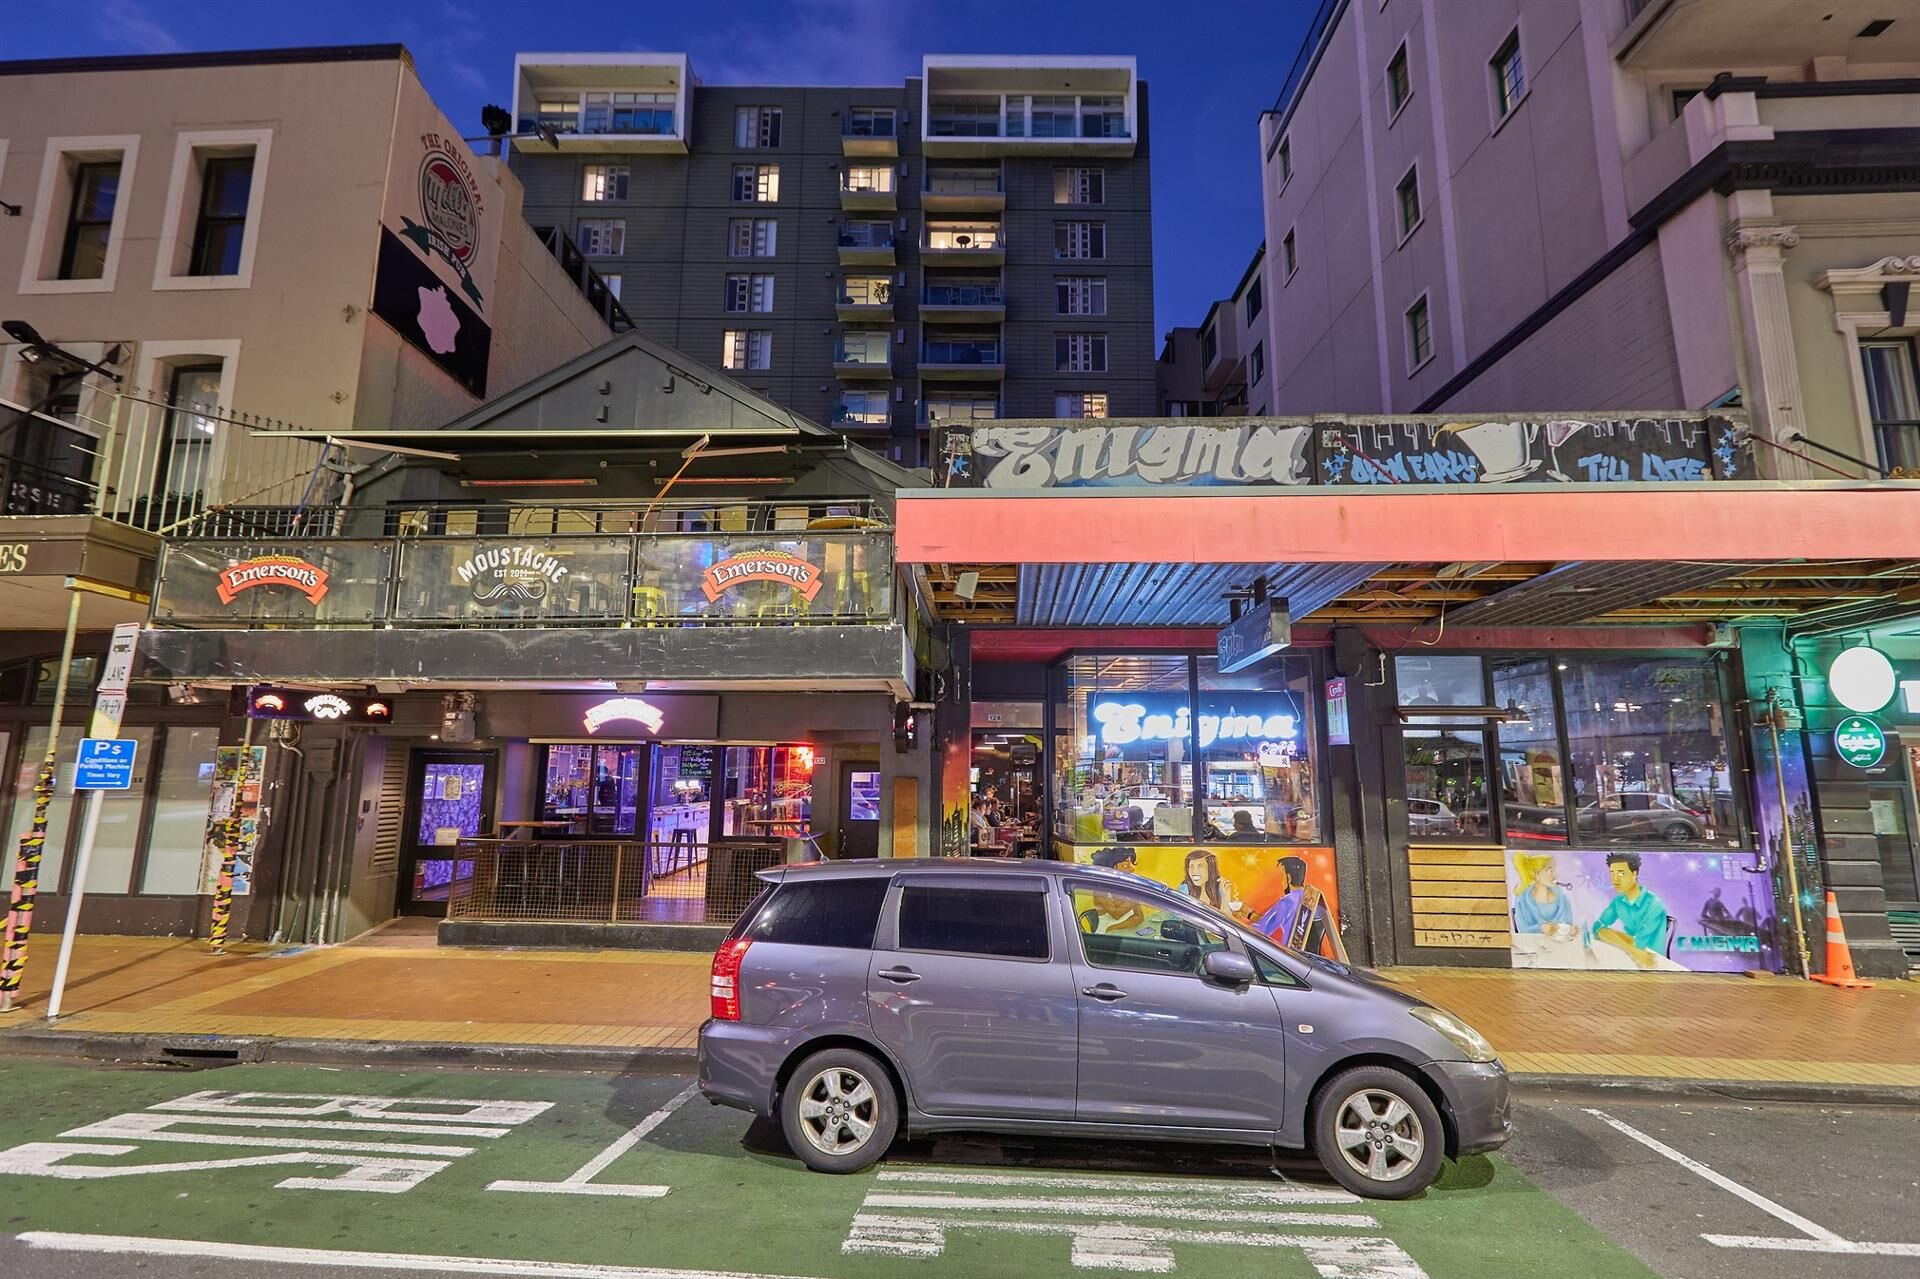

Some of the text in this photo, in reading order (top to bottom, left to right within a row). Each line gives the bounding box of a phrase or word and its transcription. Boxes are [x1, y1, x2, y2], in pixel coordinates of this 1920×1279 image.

[420, 132, 484, 216] THE ORIGINAL
[428, 233, 467, 278] IRISH PUB
[971, 426, 1312, 488] Enigma
[1407, 450, 1479, 483] EARLY
[1641, 452, 1706, 482] LATE
[228, 564, 319, 587] Emerson's
[457, 546, 568, 583] MOUSTACHE
[494, 569, 507, 578] EST
[712, 560, 810, 584] Emerson's
[94, 742, 111, 755] P
[79, 763, 103, 771] Parking
